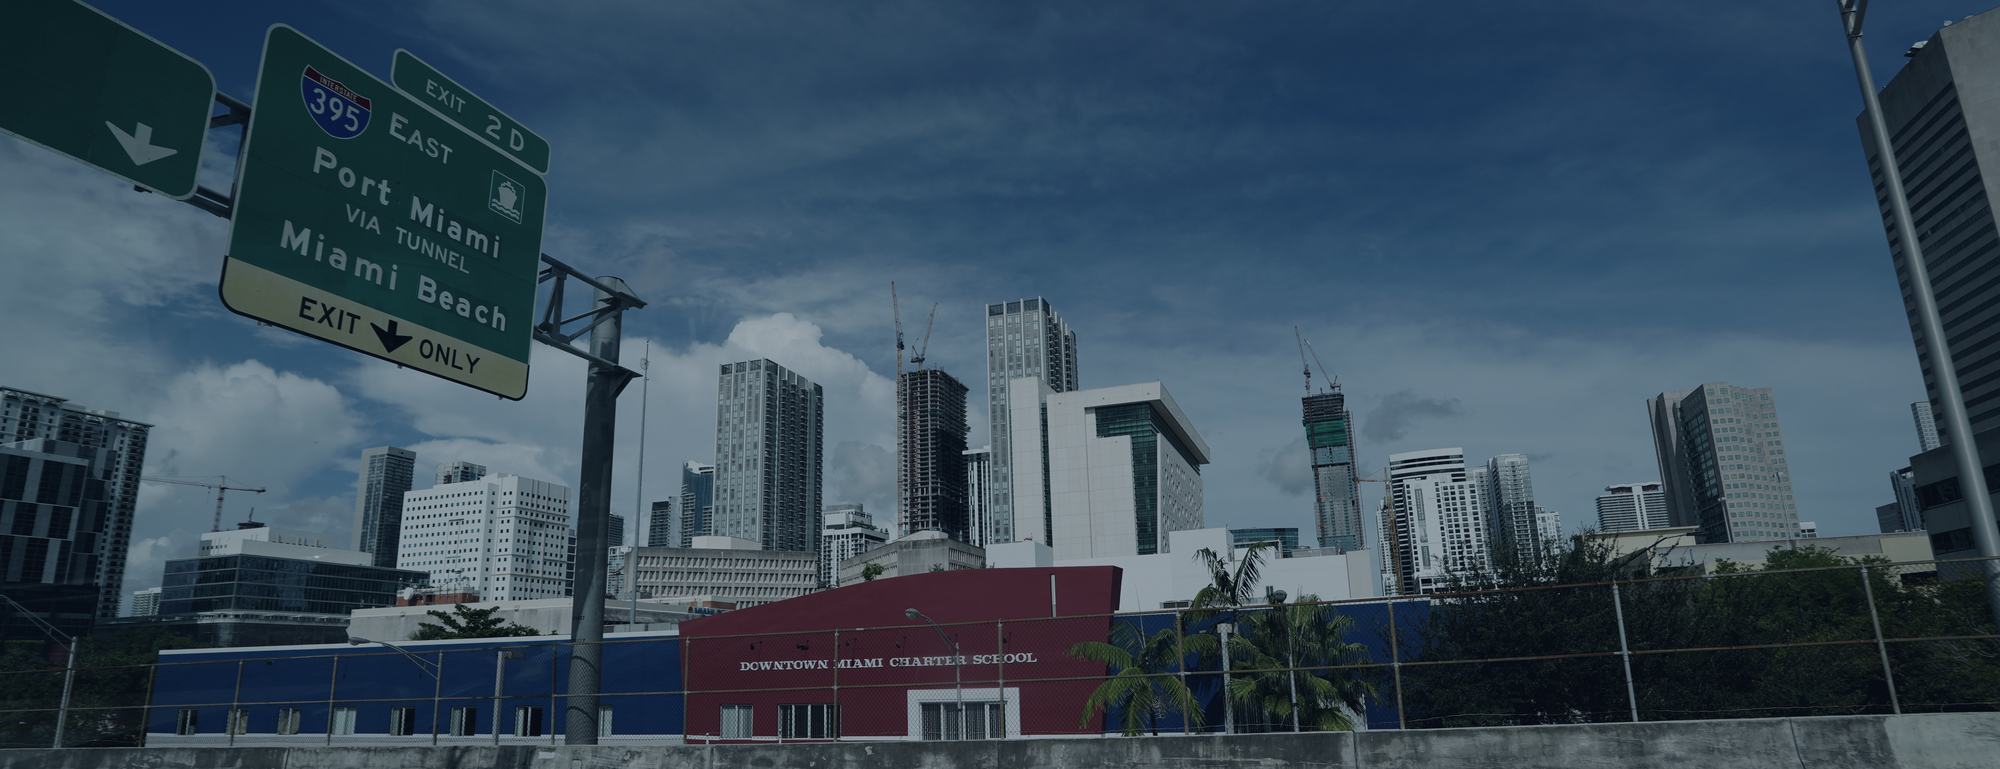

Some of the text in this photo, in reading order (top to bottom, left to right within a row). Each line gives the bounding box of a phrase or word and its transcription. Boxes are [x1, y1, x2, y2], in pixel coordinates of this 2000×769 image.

[309, 87, 360, 132] 395
[319, 75, 358, 103] INTERSTATE
[425, 79, 467, 114] EXIT
[388, 111, 453, 165] EAST
[312, 145, 500, 260] Port Miami
[345, 203, 470, 275] VIA TUNNEL
[279, 219, 506, 332] Miami Beach
[298, 295, 481, 375] EXIT ONLY
[740, 659, 829, 671] DOWNTOWN
[833, 657, 883, 669] MIAMI
[889, 655, 967, 668] CHARTER
